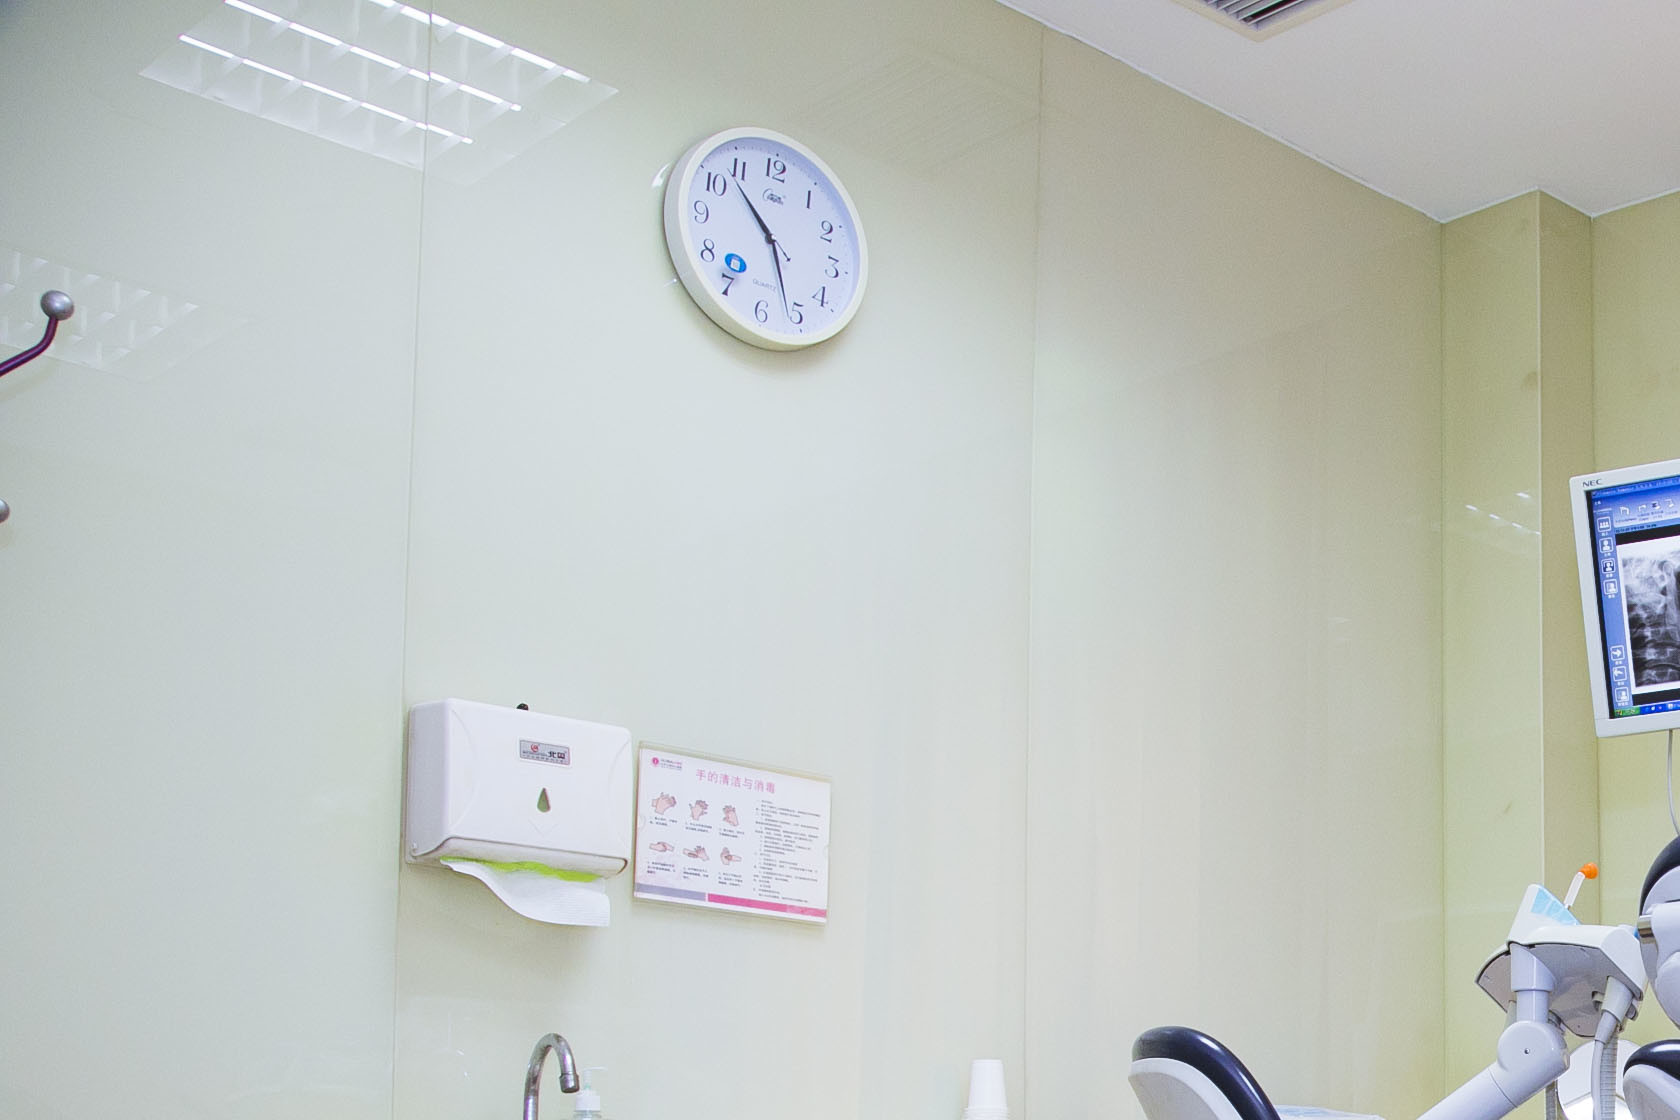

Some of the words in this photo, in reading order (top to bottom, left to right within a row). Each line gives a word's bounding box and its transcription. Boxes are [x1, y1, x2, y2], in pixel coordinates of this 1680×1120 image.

[731, 157, 747, 182] 11
[766, 157, 786, 183] 12
[706, 172, 727, 196] 10
[806, 189, 812, 210] 1
[694, 200, 709, 224] 9
[820, 220, 834, 243] 2
[700, 238, 715, 262] 8
[825, 255, 840, 279] 3
[721, 273, 734, 296] 7
[812, 286, 828, 307] 4
[755, 300, 768, 323] 6
[789, 302, 805, 325] 5
[1582, 478, 1603, 488] NEC
[695, 769, 776, 795] 手的清洁与消毒
